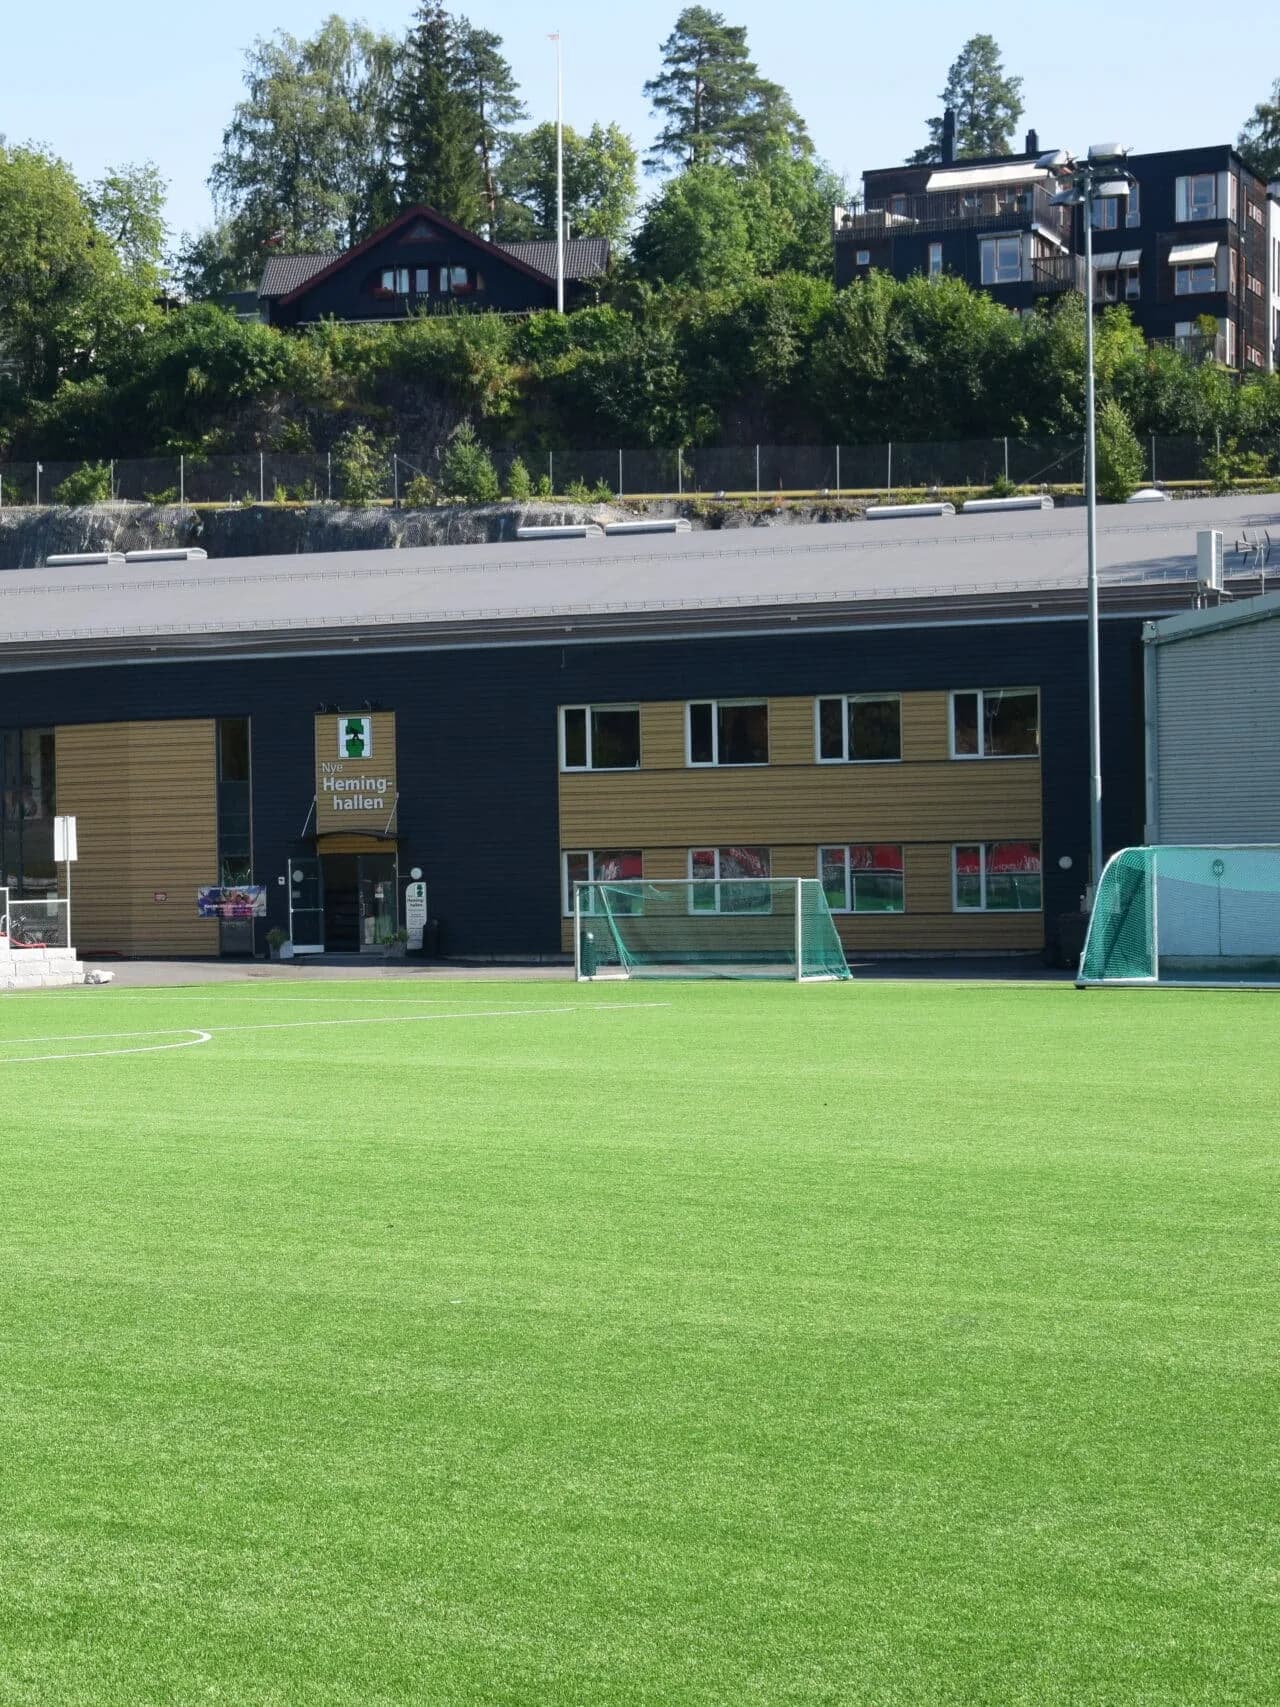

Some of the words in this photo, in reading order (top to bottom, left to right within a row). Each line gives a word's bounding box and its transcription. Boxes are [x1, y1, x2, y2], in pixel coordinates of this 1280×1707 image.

[322, 763, 343, 775] Nye
[323, 776, 393, 793] Heming-
[333, 795, 384, 810] hallen
